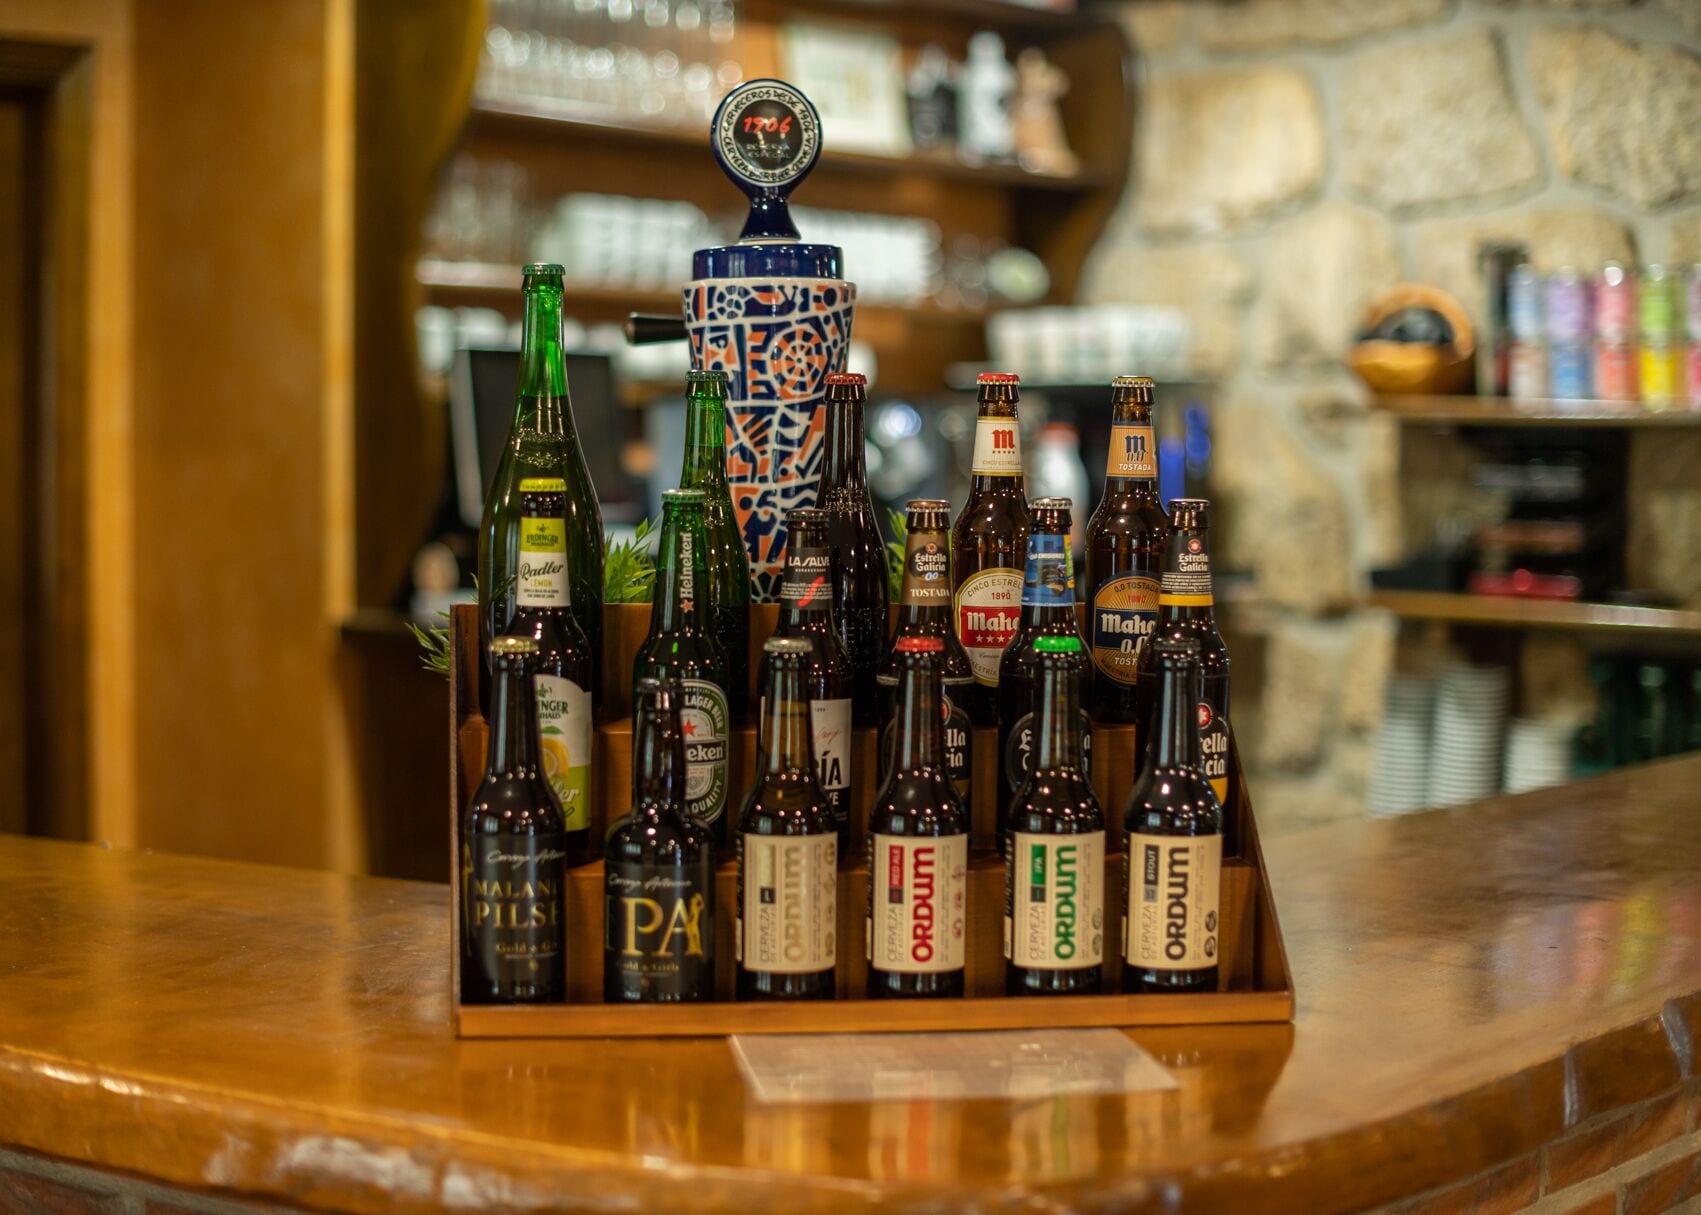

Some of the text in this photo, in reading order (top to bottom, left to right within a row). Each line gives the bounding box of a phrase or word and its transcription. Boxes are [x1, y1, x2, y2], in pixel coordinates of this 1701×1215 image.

[743, 116, 793, 133] 1906
[1119, 463, 1151, 471] TOSTADA
[680, 531, 694, 599] Heineken
[788, 556, 801, 567] LA
[914, 552, 947, 563] Estrella
[1178, 552, 1208, 563] Estrella
[520, 560, 564, 581] Radler
[916, 561, 946, 572] Galicia
[1179, 562, 1208, 572] Galicia
[910, 588, 951, 598] TOSTADA
[967, 580, 990, 598] CINCO
[991, 592, 1012, 600] 1890
[684, 694, 714, 711] LAGER
[691, 779, 722, 814] QUALITY
[1035, 856, 1043, 874] IPA
[1147, 850, 1156, 880] STOUT
[760, 906, 770, 963] CERVEZA
[888, 906, 898, 962] CERVEZA
[1030, 904, 1041, 960] CERVEZA
[1141, 905, 1151, 960] CERVEZA
